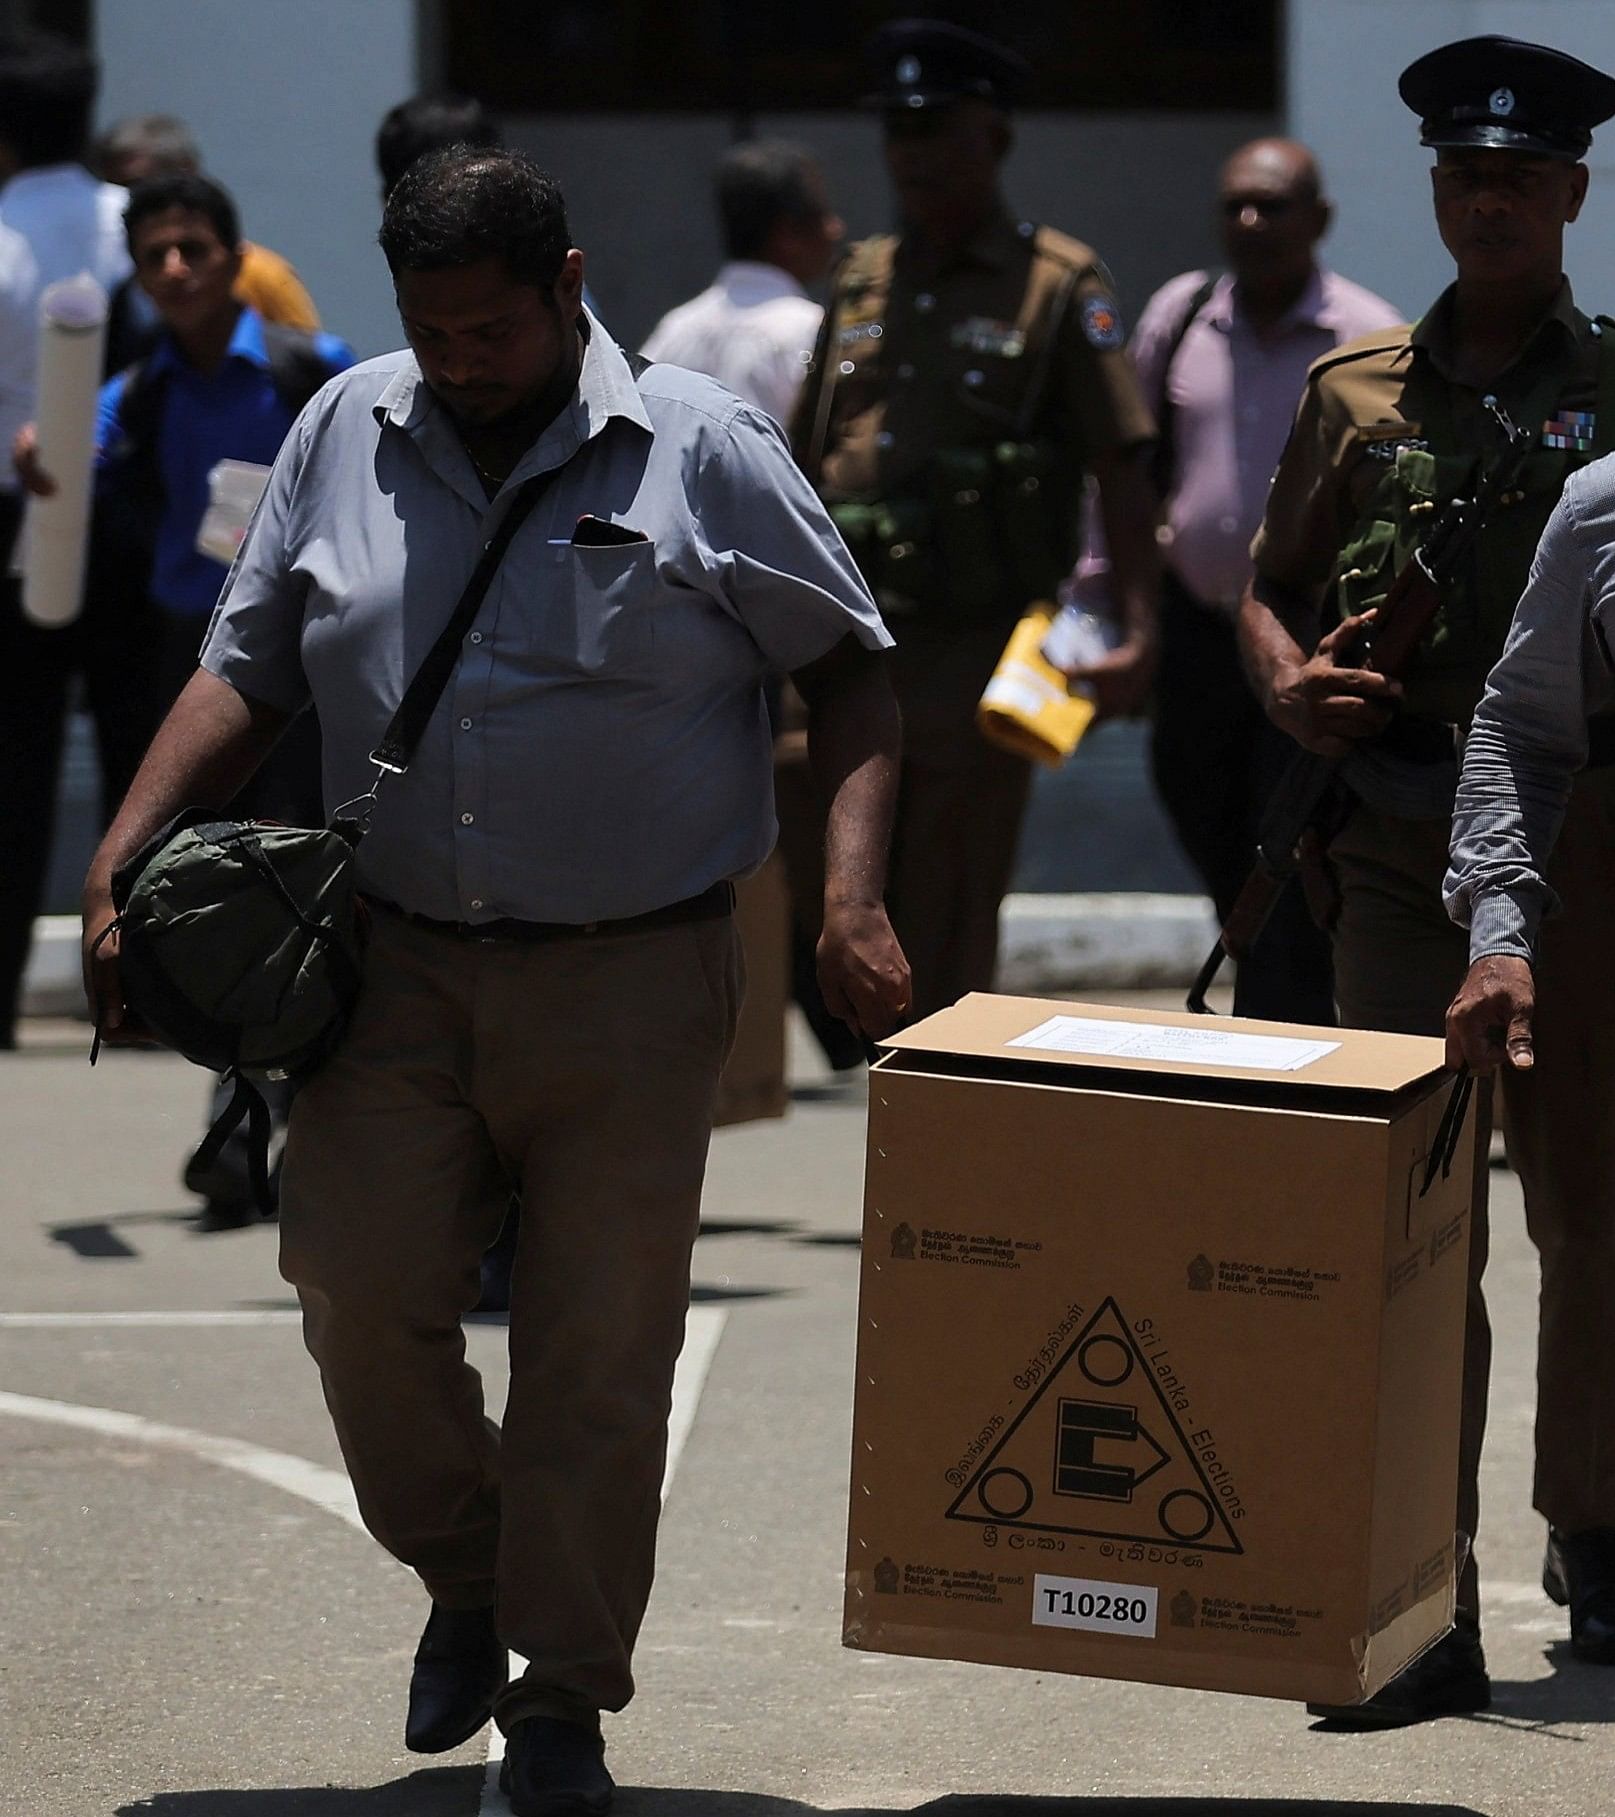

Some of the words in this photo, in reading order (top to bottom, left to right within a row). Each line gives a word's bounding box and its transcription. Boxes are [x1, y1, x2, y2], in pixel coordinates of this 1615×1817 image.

[920, 1250, 959, 1264] Election
[961, 1255, 1021, 1269] Commission
[1218, 1282, 1257, 1294] Election
[1259, 1286, 1320, 1301] Commission
[944, 1414, 1005, 1489] இலங்கை
[1012, 1302, 1085, 1391] தேர்தல்கள்
[1134, 1317, 1161, 1348] Sri
[1150, 1350, 1190, 1411] Lanka
[1191, 1428, 1246, 1520] Elections
[1008, 1533, 1066, 1552] ලංකා
[1099, 1541, 1204, 1569] මැතිවරණ
[903, 1584, 942, 1598] Election
[944, 1589, 1004, 1605] Commission
[1043, 1588, 1147, 1624] T10280
